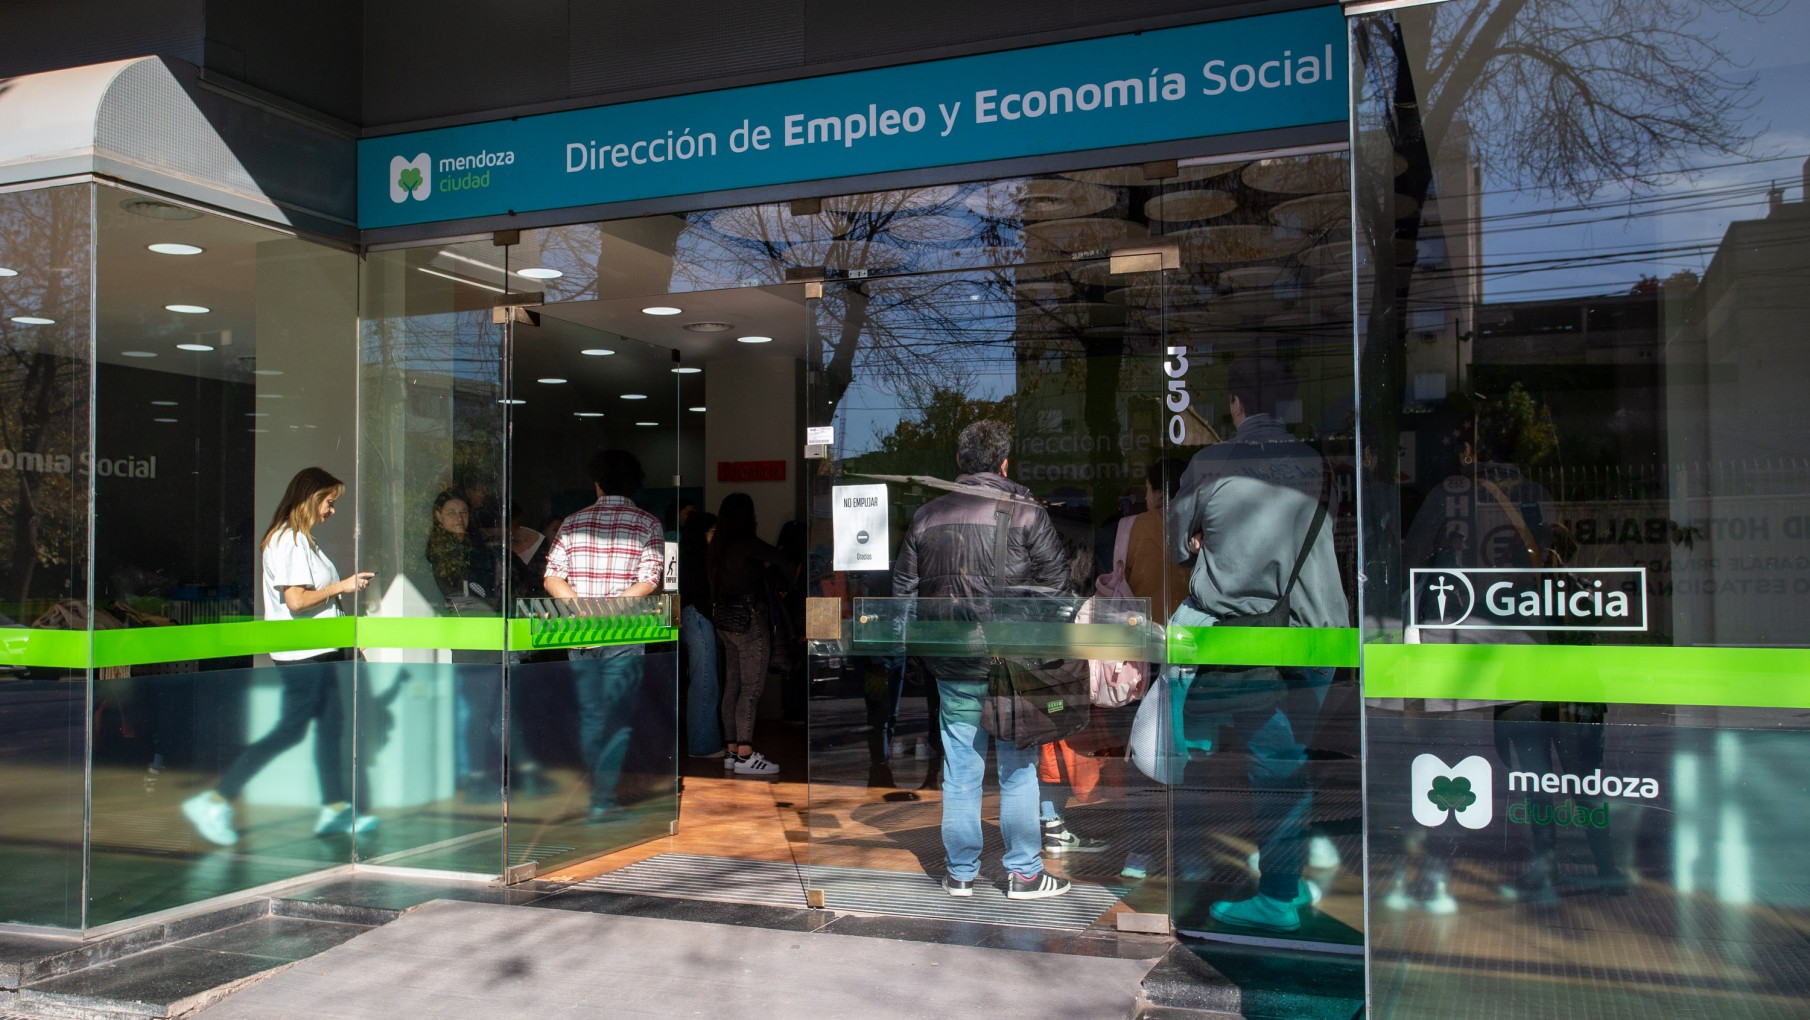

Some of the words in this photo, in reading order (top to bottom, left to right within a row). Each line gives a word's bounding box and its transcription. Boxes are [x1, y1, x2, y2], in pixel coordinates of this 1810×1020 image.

[566, 128, 717, 173] Dirección
[729, 120, 771, 154] de
[784, 104, 926, 148] Empleo
[939, 102, 961, 137] y
[975, 67, 1186, 124] Economía
[1203, 44, 1333, 96] Social
[439, 149, 515, 173] mendoza
[439, 170, 491, 193] ciudad
[1164, 346, 1190, 445] 350
[1119, 429, 1151, 451] de
[79, 450, 157, 478] Social
[844, 498, 852, 508] NO
[853, 497, 878, 508] EMPUJAR
[856, 552, 872, 561] Gracias
[1485, 579, 1629, 617] Galicia
[1508, 769, 1660, 799] mendoza
[1508, 798, 1610, 829] ciudad
